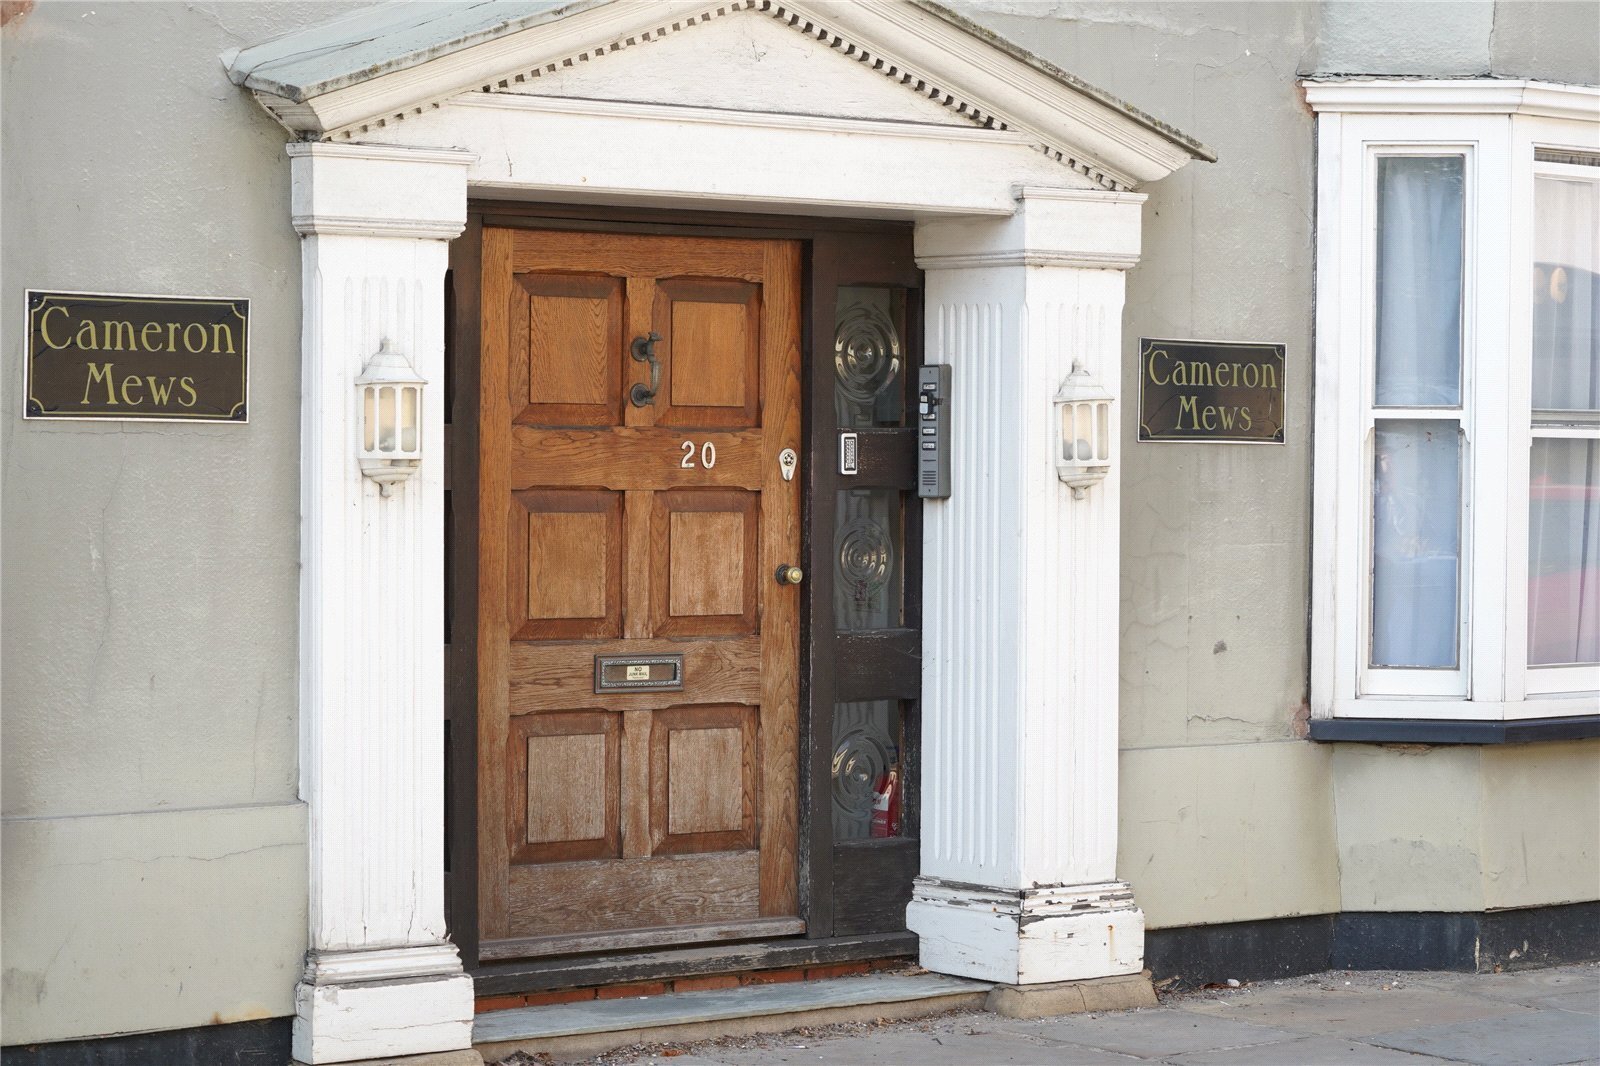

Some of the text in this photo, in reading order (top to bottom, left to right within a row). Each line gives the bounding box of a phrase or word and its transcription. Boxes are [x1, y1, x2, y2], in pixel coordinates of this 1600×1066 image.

[41, 306, 236, 354] Cameron
[80, 362, 197, 407] Mews
[1149, 350, 1277, 388] Cameron
[1175, 395, 1252, 431] Mews
[681, 440, 716, 469] 20
